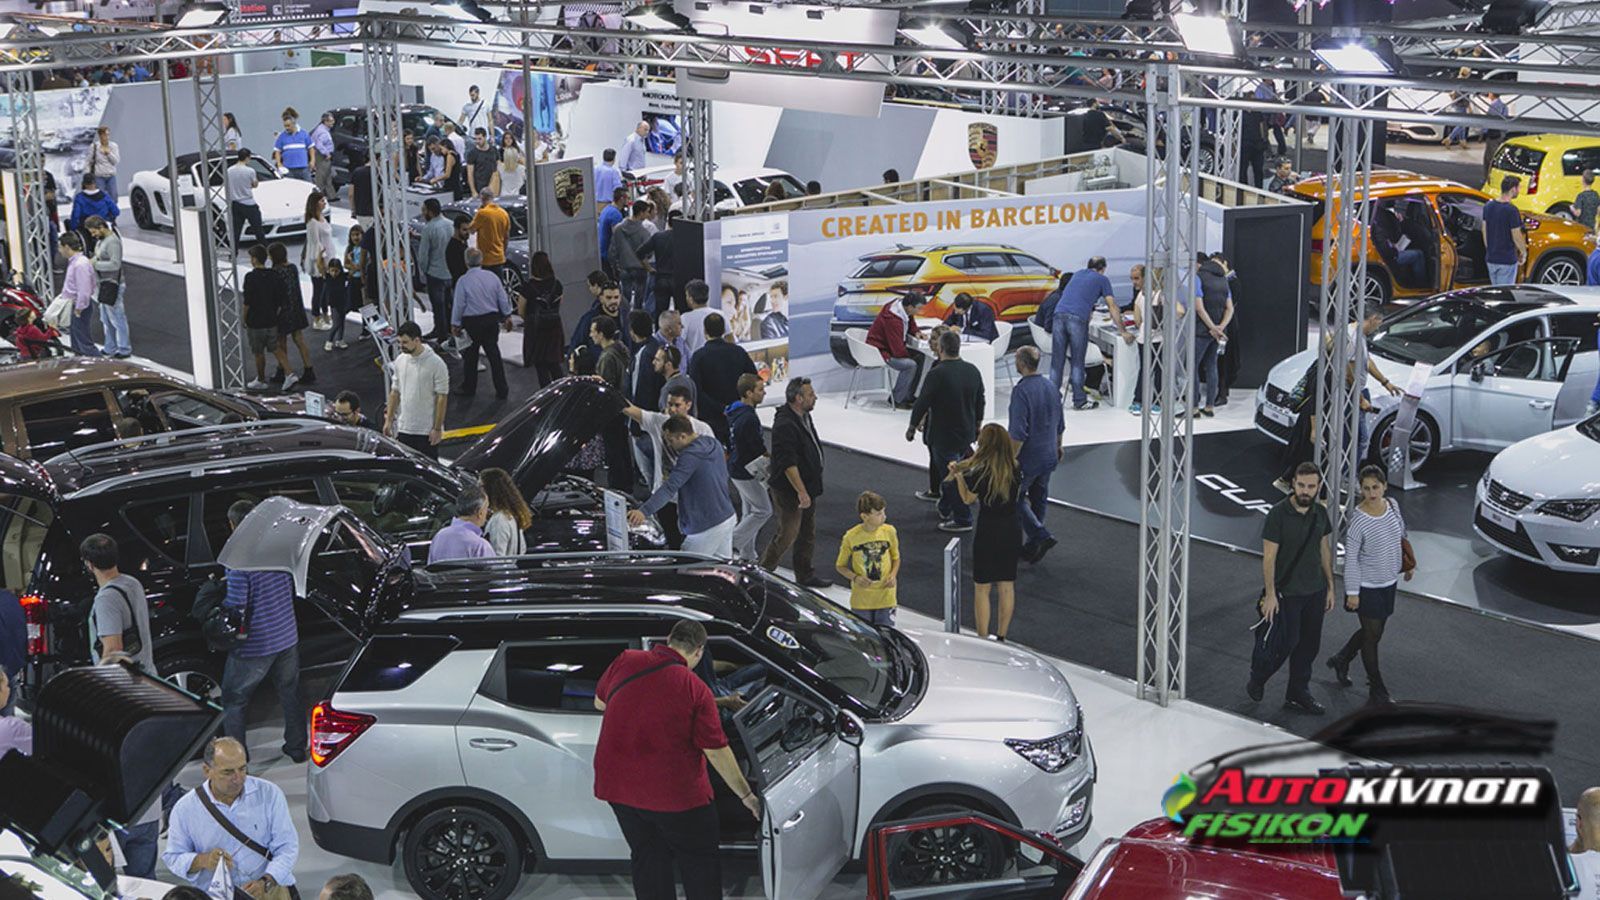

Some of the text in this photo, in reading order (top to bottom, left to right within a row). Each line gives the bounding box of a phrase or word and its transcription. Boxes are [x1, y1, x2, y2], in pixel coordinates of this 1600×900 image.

[821, 200, 1110, 238] CREATED IN BARCELONA
